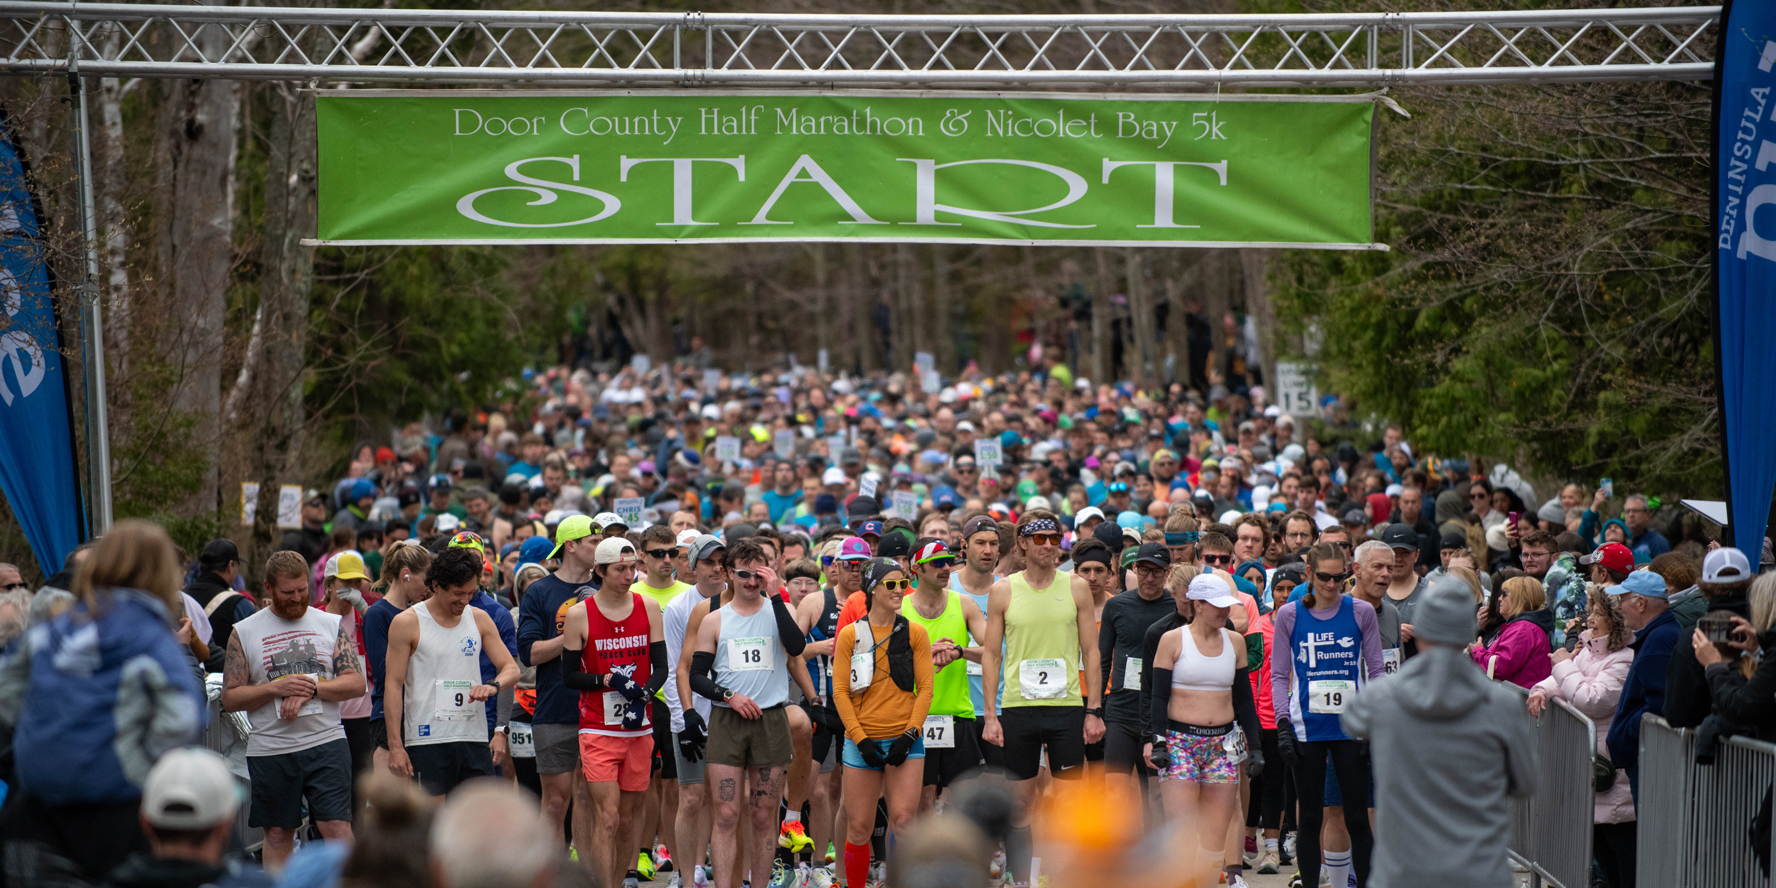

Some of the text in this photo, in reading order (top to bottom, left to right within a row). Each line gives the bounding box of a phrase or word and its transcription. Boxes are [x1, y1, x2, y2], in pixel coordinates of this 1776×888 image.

[453, 105, 1228, 149] Door County Half Marathon & Nicolet Bay 5k
[456, 154, 1228, 228] START
[1284, 392, 1311, 411] 15
[616, 505, 641, 514] CHRIS
[865, 522, 875, 531] C
[595, 634, 648, 651] WISCONSIN
[1316, 632, 1335, 641] LIFE
[599, 648, 647, 659] TRACK CLUB
[742, 649, 761, 663] 18
[1317, 651, 1354, 660] Runners
[1038, 671, 1048, 684] 2
[455, 692, 464, 707] 9
[1323, 692, 1342, 706] 19
[511, 732, 531, 745] 951
